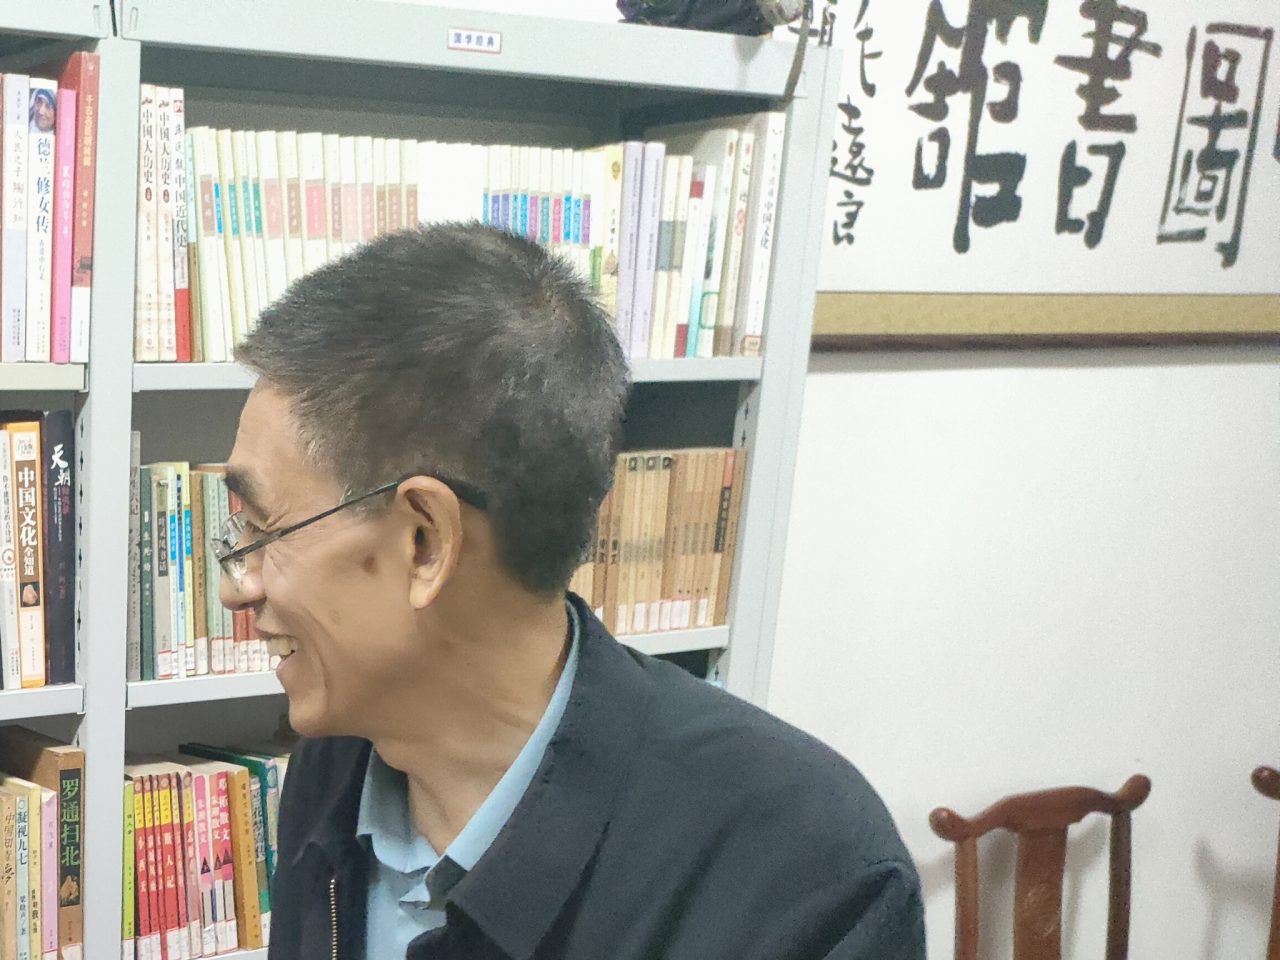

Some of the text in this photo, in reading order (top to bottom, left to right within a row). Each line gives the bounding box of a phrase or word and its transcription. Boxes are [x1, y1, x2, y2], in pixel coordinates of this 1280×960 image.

[17, 811, 28, 866] 凝视九七
[60, 778, 81, 867] 罗通扫北
